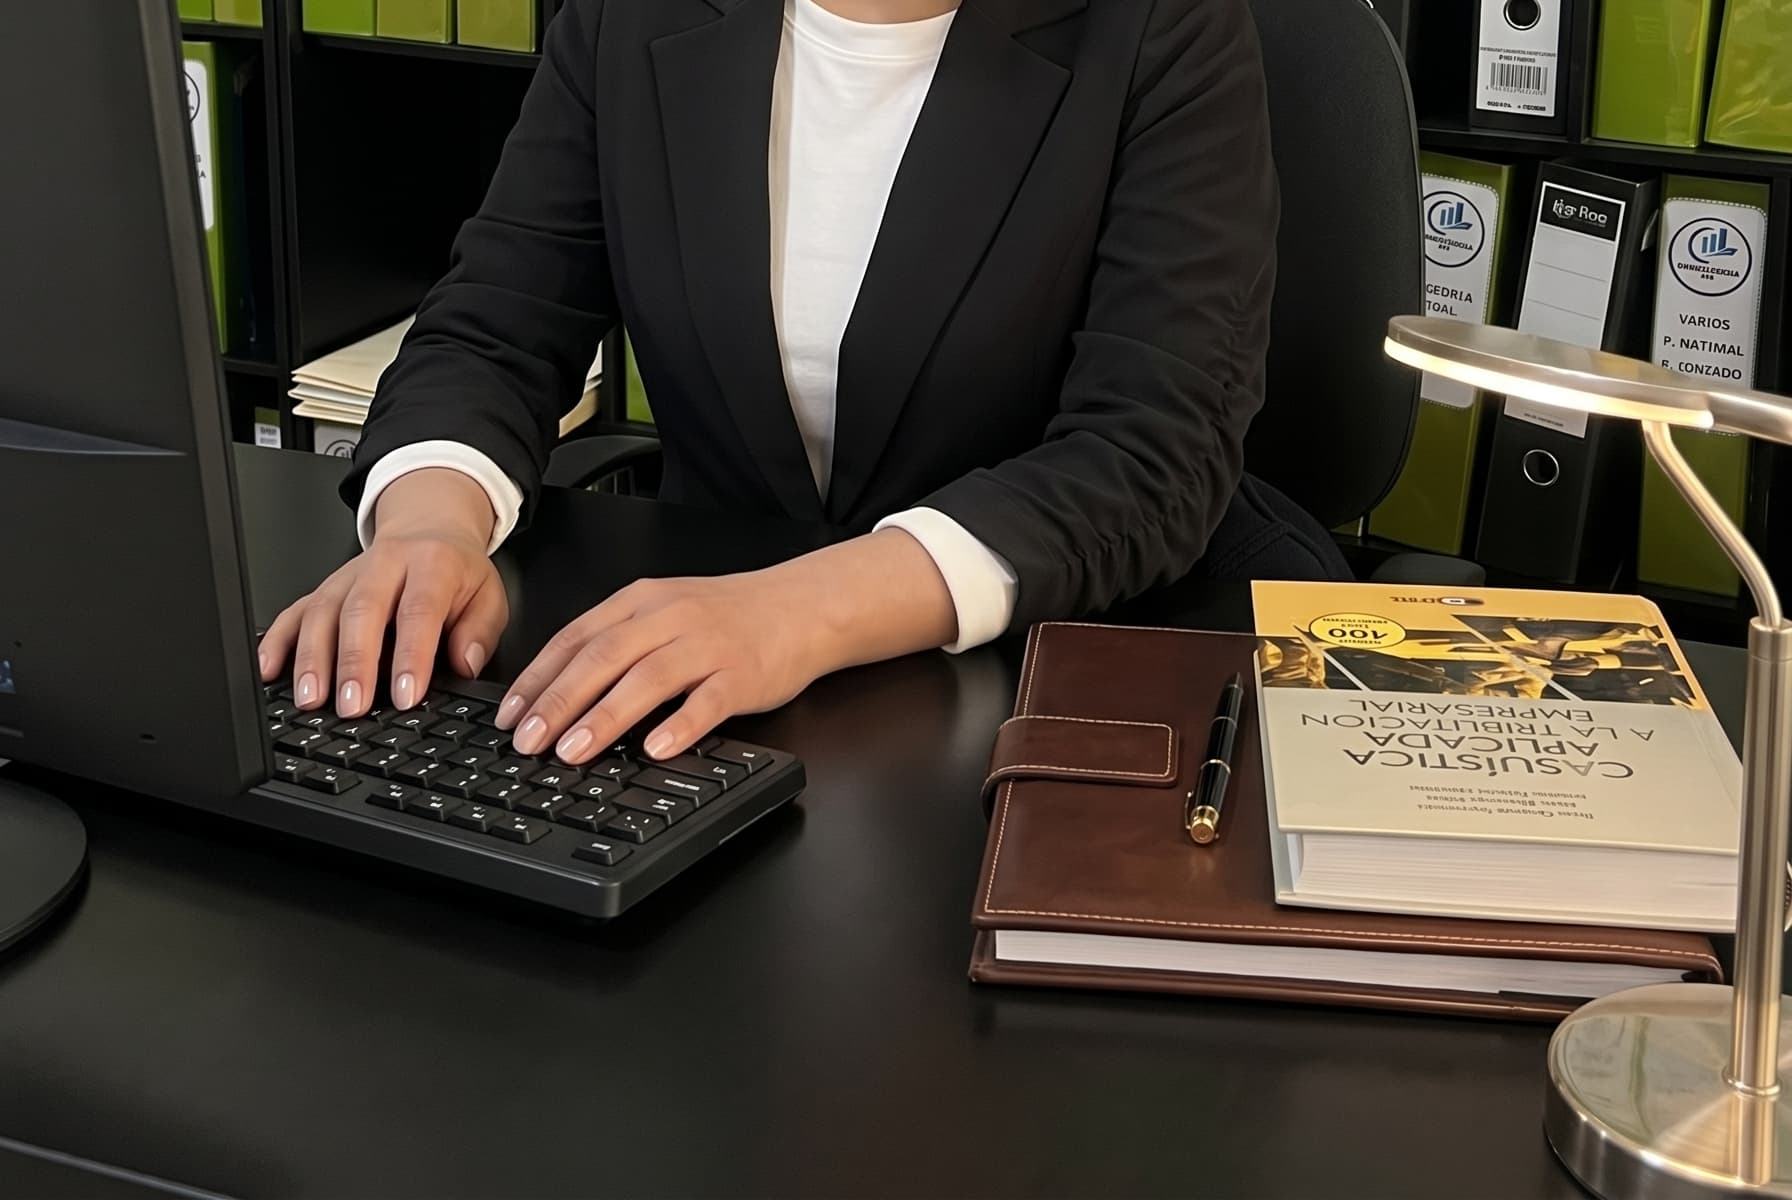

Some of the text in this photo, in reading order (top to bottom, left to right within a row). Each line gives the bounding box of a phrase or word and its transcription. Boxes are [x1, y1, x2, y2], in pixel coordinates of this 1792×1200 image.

[1679, 313, 1731, 331] VARIOS
[1663, 335, 1745, 357] P. NATIMAL
[1327, 626, 1388, 641] 100
[1349, 698, 1593, 723] EMPRESARIAL
[1362, 730, 1599, 757] APLICADA
[1570, 724, 1619, 741] LA
[1343, 747, 1635, 779] CASUÍSTICA
